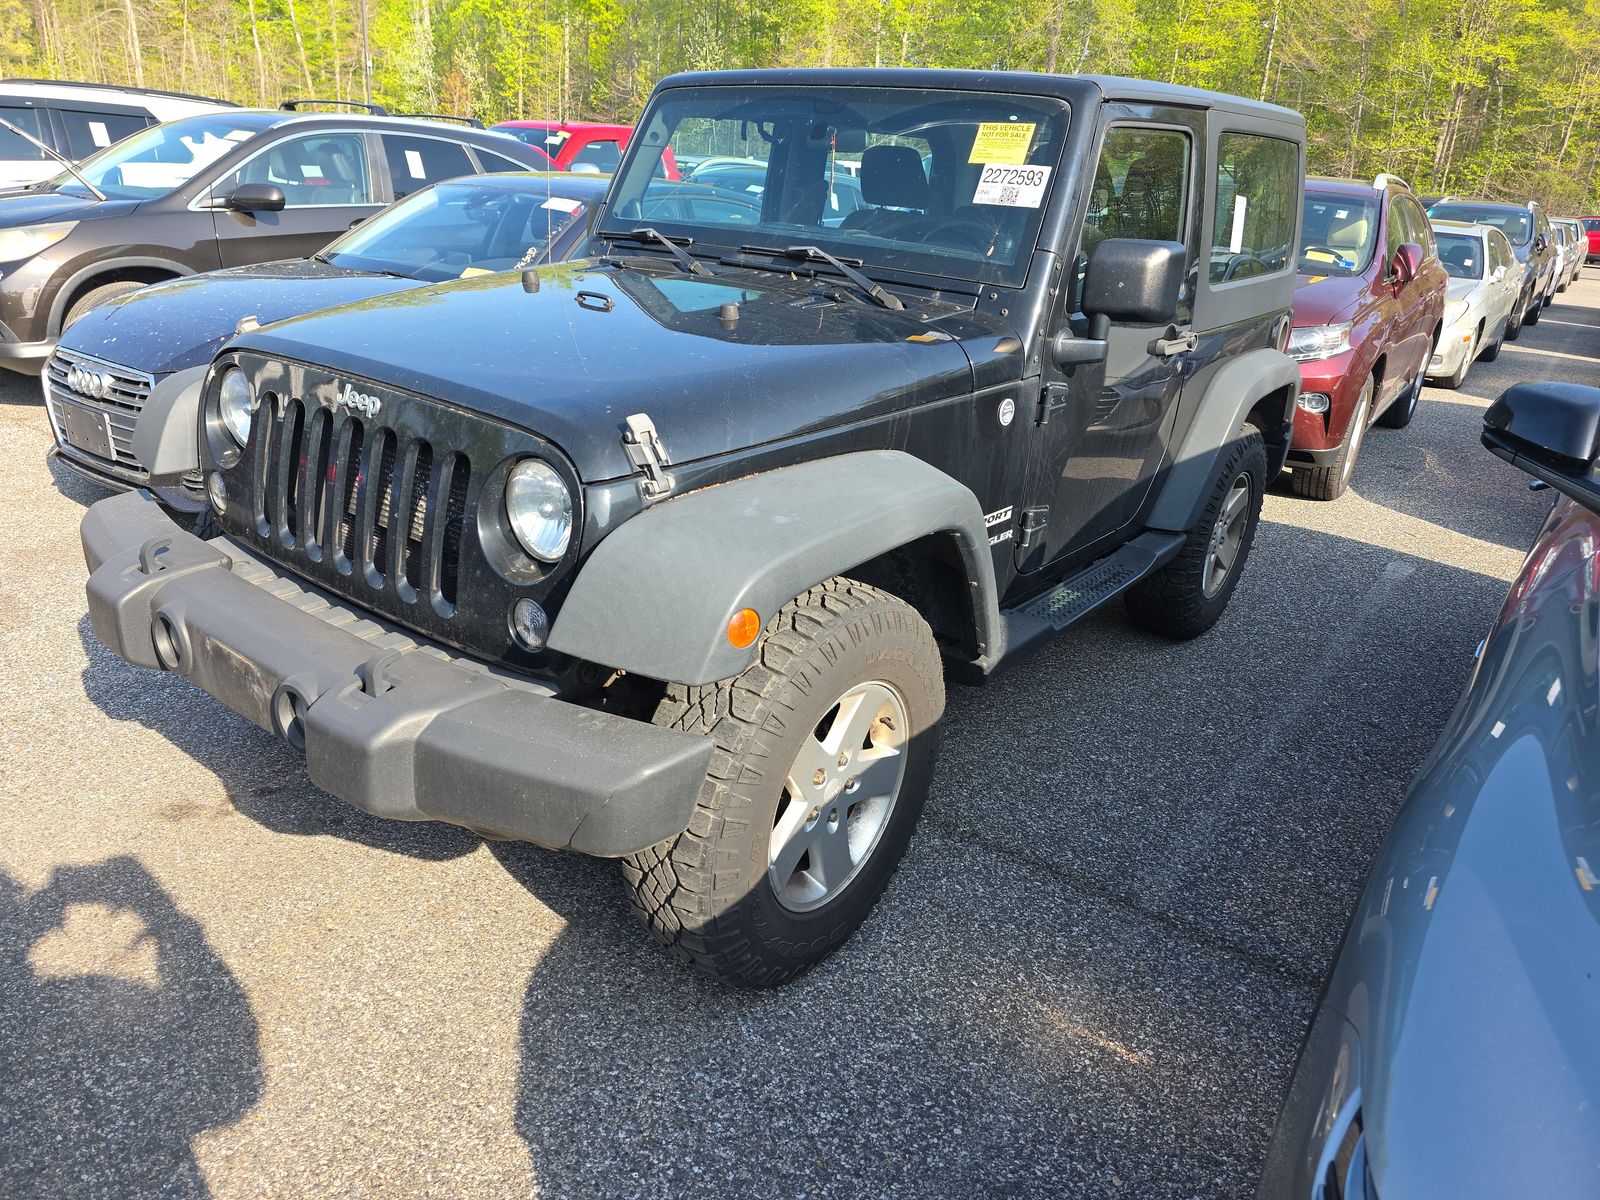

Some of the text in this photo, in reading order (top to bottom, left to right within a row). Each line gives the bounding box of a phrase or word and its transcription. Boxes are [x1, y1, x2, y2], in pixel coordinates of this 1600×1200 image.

[982, 124, 998, 132] THIS
[982, 168, 1044, 187] 2272593
[336, 383, 381, 419] Jeep
[985, 509, 1012, 524] ORT
